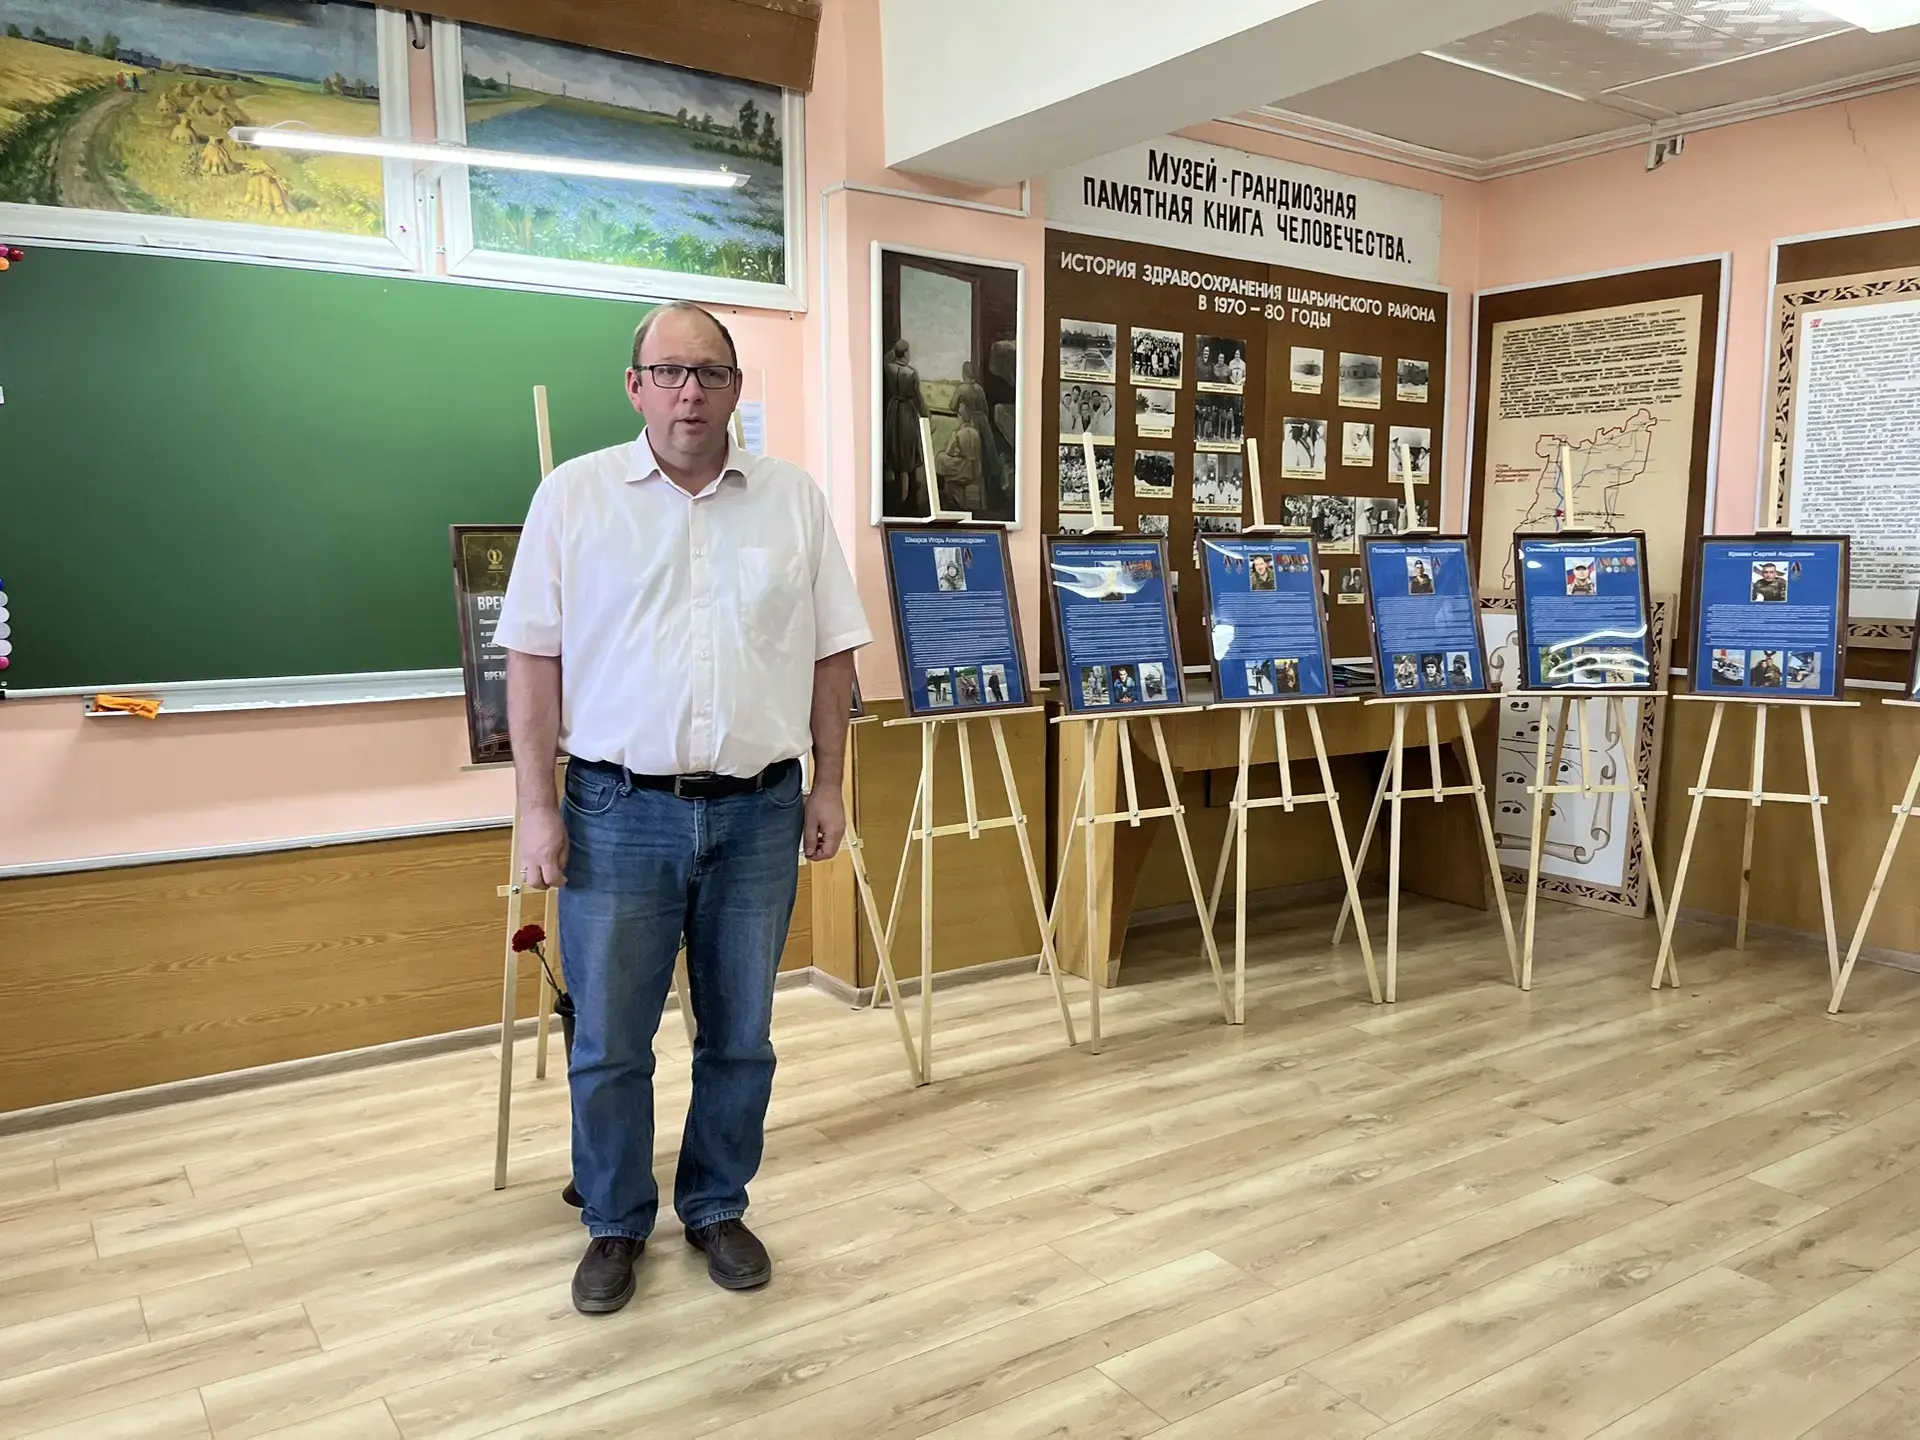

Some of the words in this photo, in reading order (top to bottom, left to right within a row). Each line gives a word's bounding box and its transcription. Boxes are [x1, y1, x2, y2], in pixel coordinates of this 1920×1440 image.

[1083, 176, 1193, 225] ПАМЯТНАЯ
[1204, 200, 1264, 237] КНИГА
[1277, 213, 1412, 264] ЧЕЛОВЕЧЕСТВА.
[1060, 251, 1137, 280] ИСТОРИЯ
[1142, 264, 1282, 301] ЗДРАВООХРАНЕНИЯ
[1287, 287, 1382, 316] ШАРЬИНСКОГО
[1387, 302, 1436, 323] РАЙОНА
[1198, 294, 1207, 310] В
[1291, 308, 1331, 329] ГОДЫ
